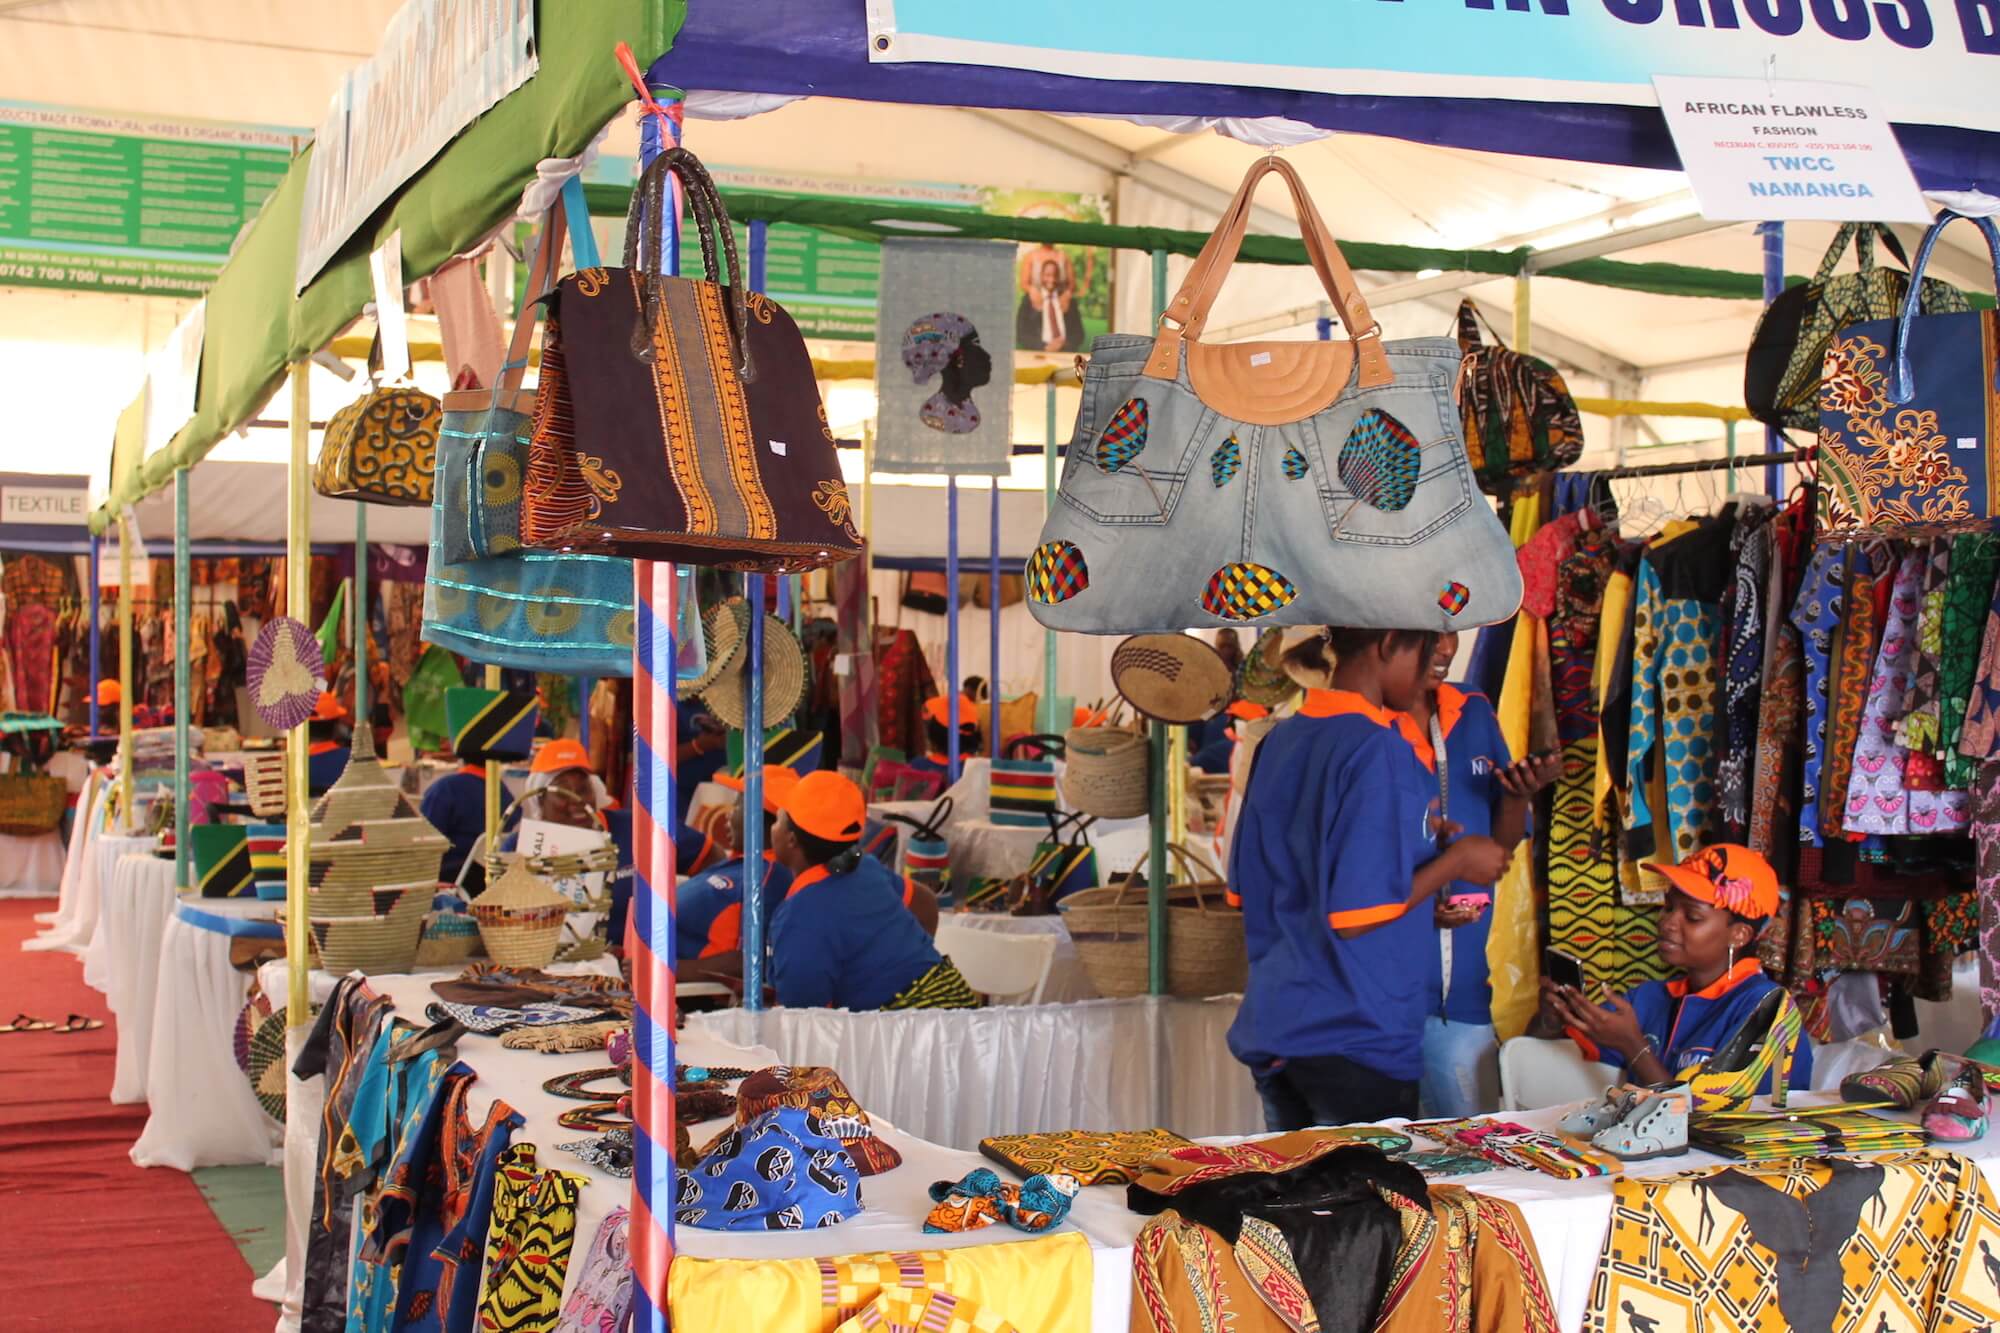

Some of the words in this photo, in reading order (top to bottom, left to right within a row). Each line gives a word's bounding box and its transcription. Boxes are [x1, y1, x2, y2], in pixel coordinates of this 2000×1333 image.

[1684, 101, 1767, 116] AFRICAN
[1771, 104, 1868, 120] FLAWLESS
[1752, 125, 1817, 137] FASHION
[1763, 156, 1836, 172] TWCC
[1748, 181, 1874, 199] NAMANGA
[0, 263, 35, 279] 0742
[39, 266, 65, 281] 700
[7, 495, 82, 513] TEXTILE
